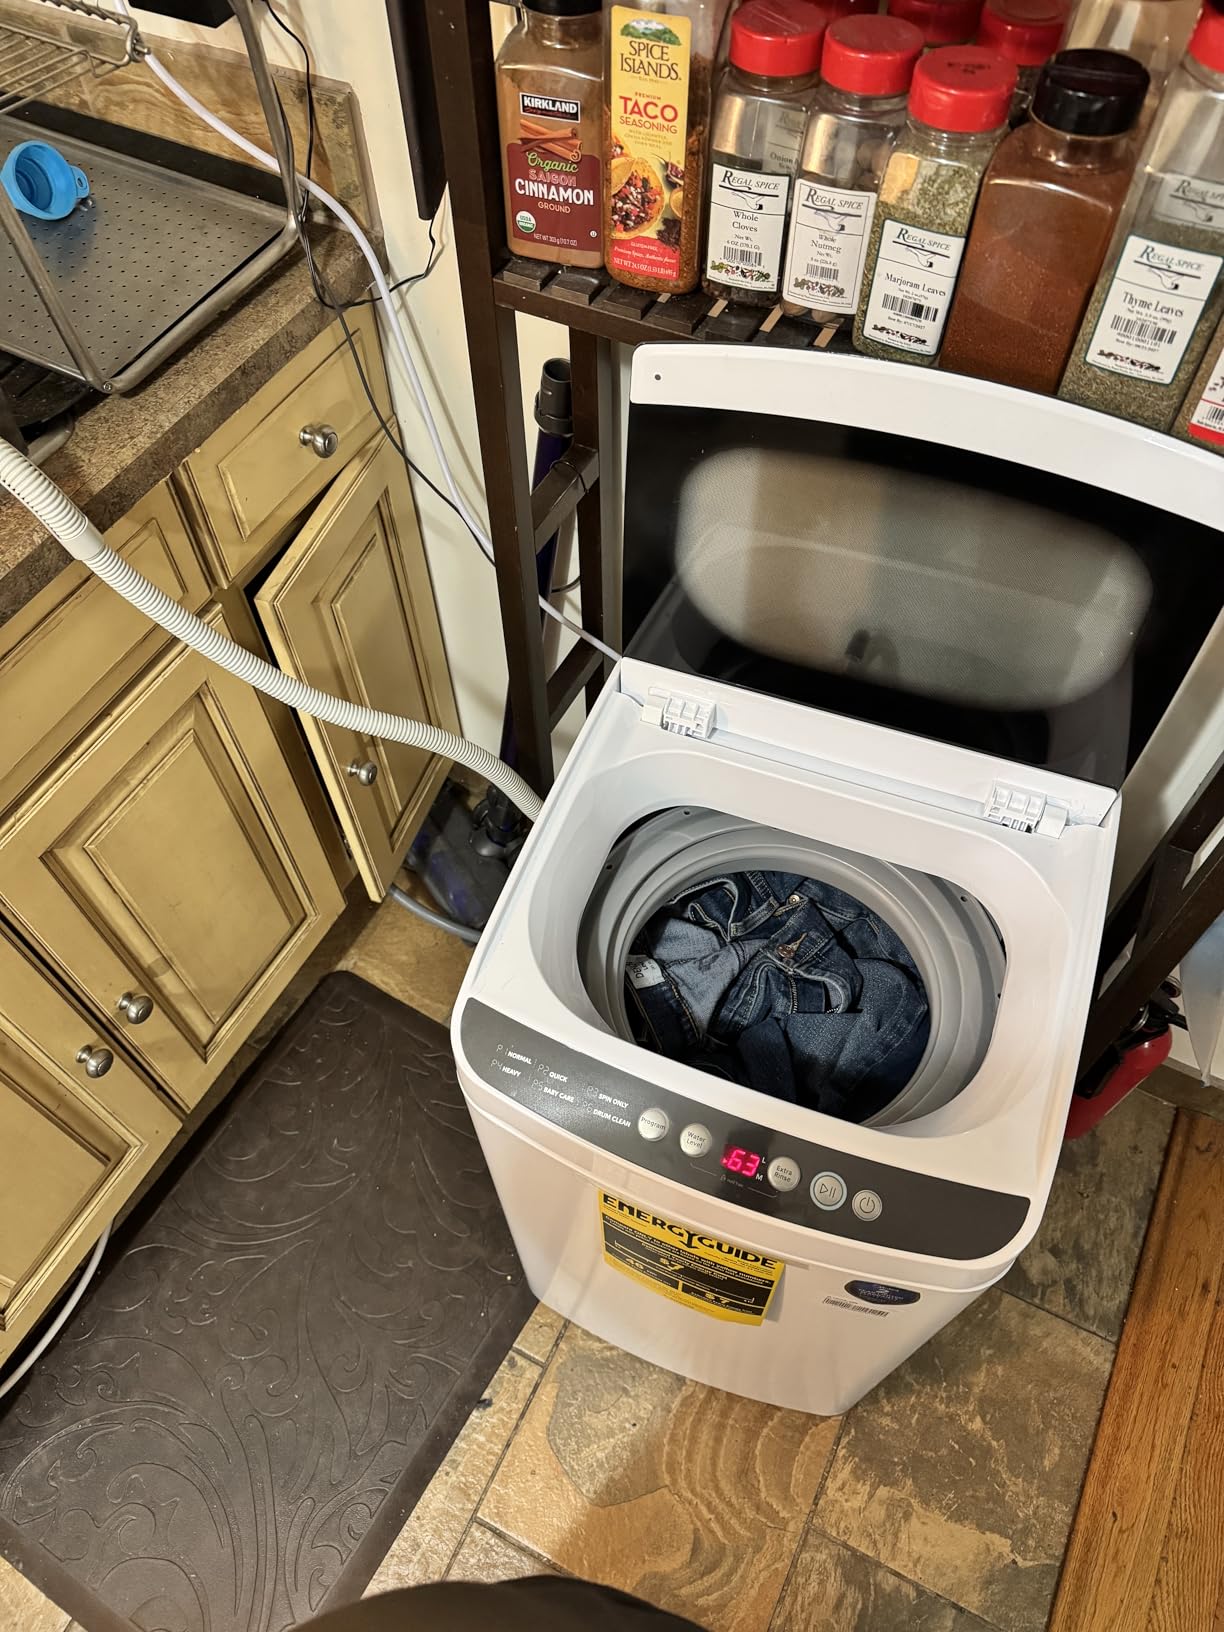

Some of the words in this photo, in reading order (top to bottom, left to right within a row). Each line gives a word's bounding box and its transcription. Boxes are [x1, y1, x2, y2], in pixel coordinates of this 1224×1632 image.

[629, 40, 670, 61] SPICE
[620, 54, 679, 80] ISLANDS
[635, 92, 661, 100] PREMIUM
[524, 96, 577, 113] KIRKLAND
[619, 96, 678, 122] TACO
[620, 116, 678, 134] SEASONING
[526, 152, 578, 172] Organic
[515, 178, 594, 205] CINNAMON
[538, 202, 570, 214] GROUND
[734, 211, 759, 222] Whole
[732, 222, 758, 232] Cloves
[811, 240, 842, 254] Nutmeg
[885, 273, 920, 289] Marjoram
[922, 284, 946, 296] Leaves
[1123, 291, 1152, 308] Thyme
[1154, 300, 1184, 317] Leaves
[508, 1051, 532, 1064] NORMAL
[502, 1066, 521, 1077] HEAVY
[549, 1072, 568, 1082] QUICK
[544, 1086, 559, 1097] BABY
[559, 1092, 574, 1102] CARE
[598, 1094, 612, 1103] SPIN
[612, 1098, 628, 1108] ONLY
[593, 1109, 611, 1120] DRUM
[612, 1116, 631, 1128] CLEAN
[641, 1116, 666, 1130] Program
[687, 1139, 702, 1148] Level
[688, 1132, 706, 1142] Water
[774, 1172, 790, 1182] Rinse
[776, 1166, 792, 1176] Extra
